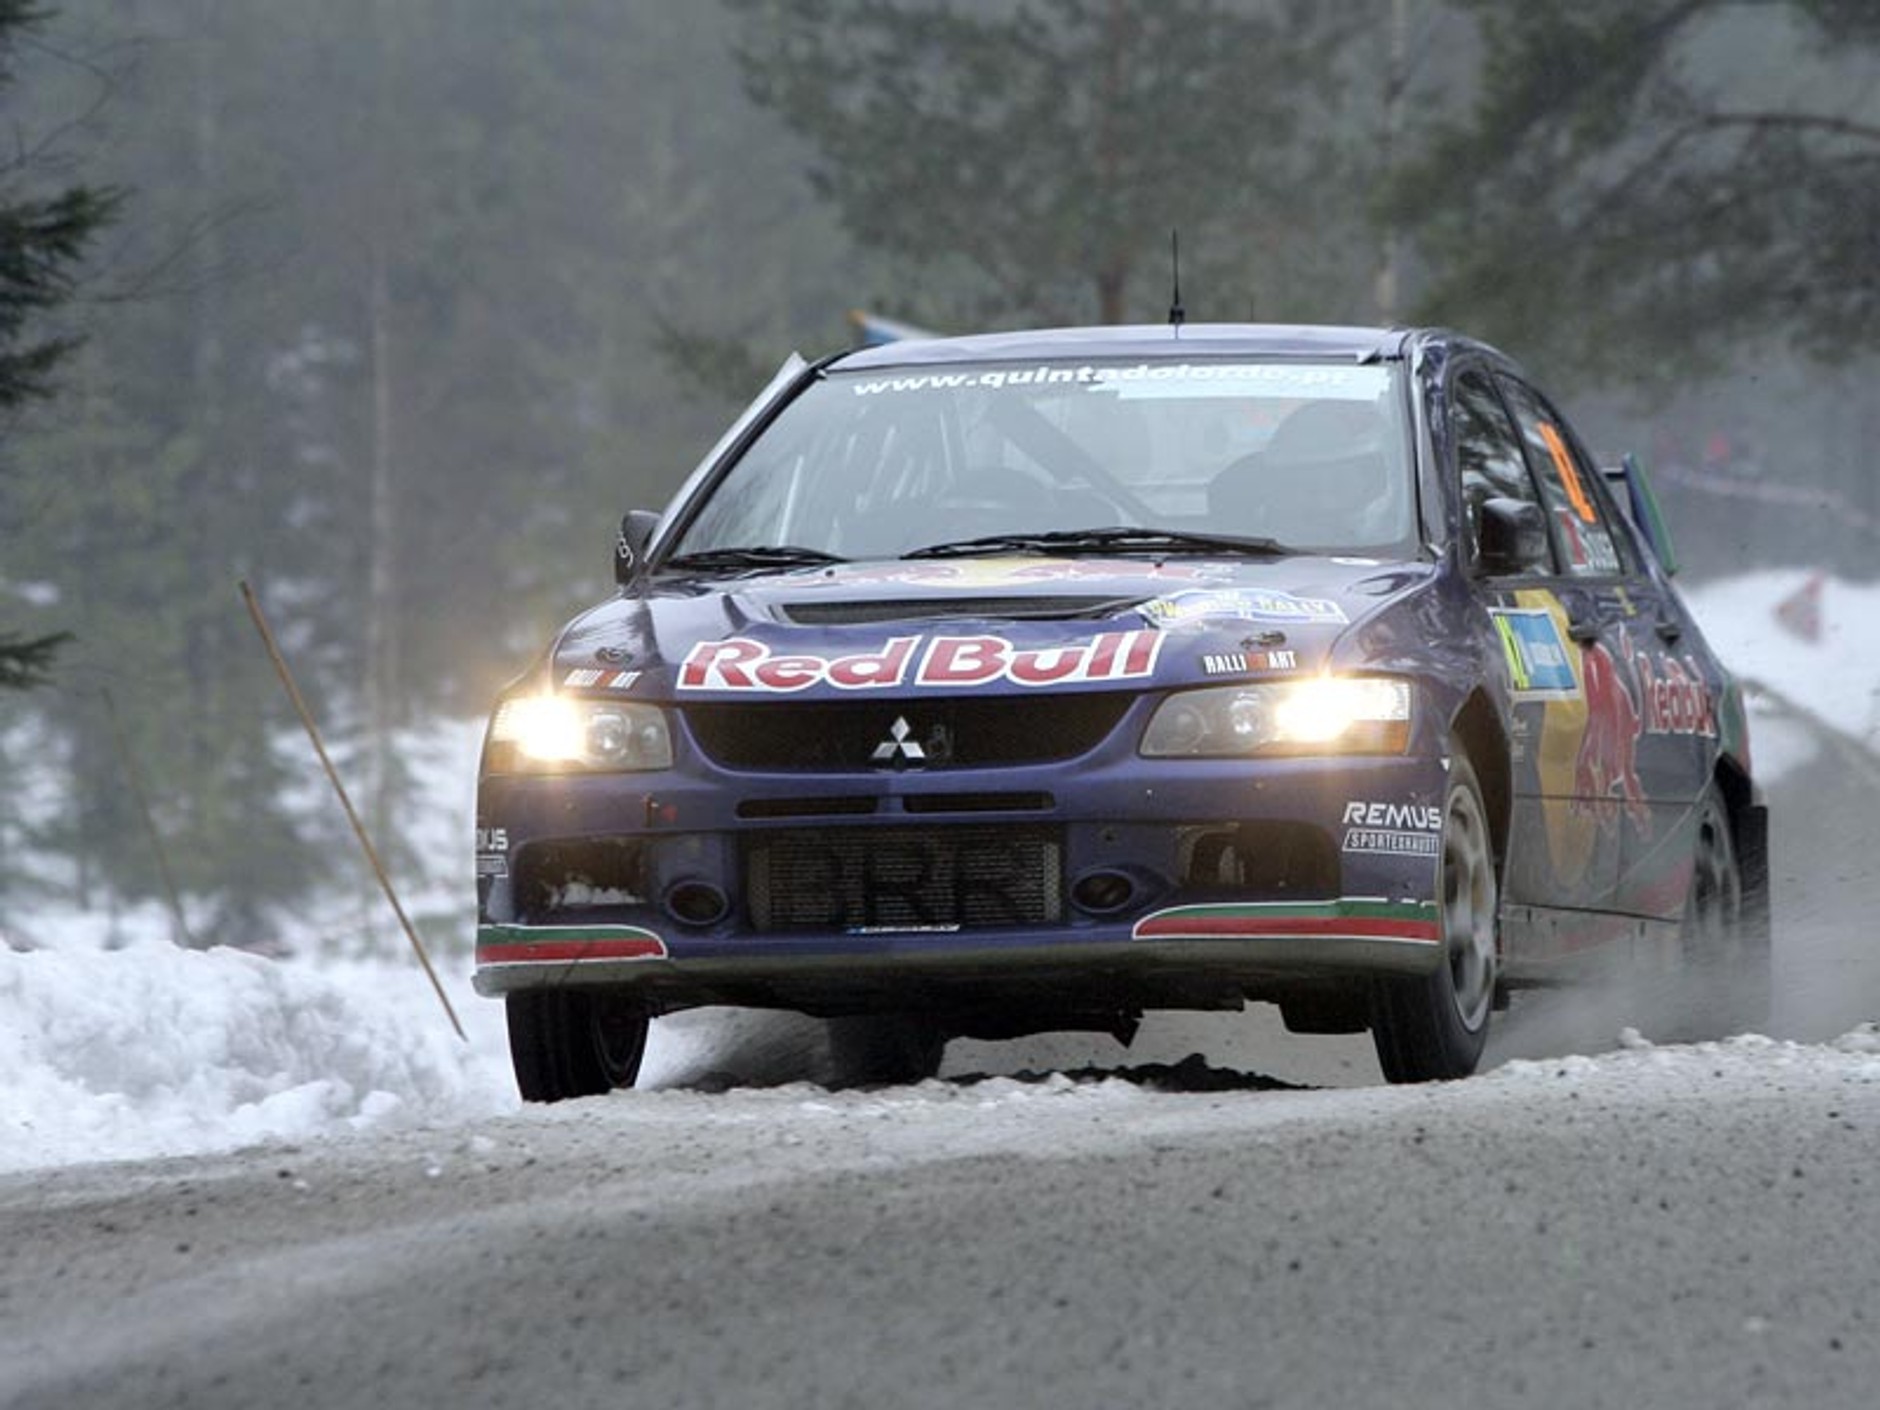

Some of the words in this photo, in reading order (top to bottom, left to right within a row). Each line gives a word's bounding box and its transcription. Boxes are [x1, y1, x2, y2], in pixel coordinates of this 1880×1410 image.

[676, 636, 923, 692] Red
[914, 630, 1165, 688] Bull
[1342, 802, 1442, 829] REMUS
